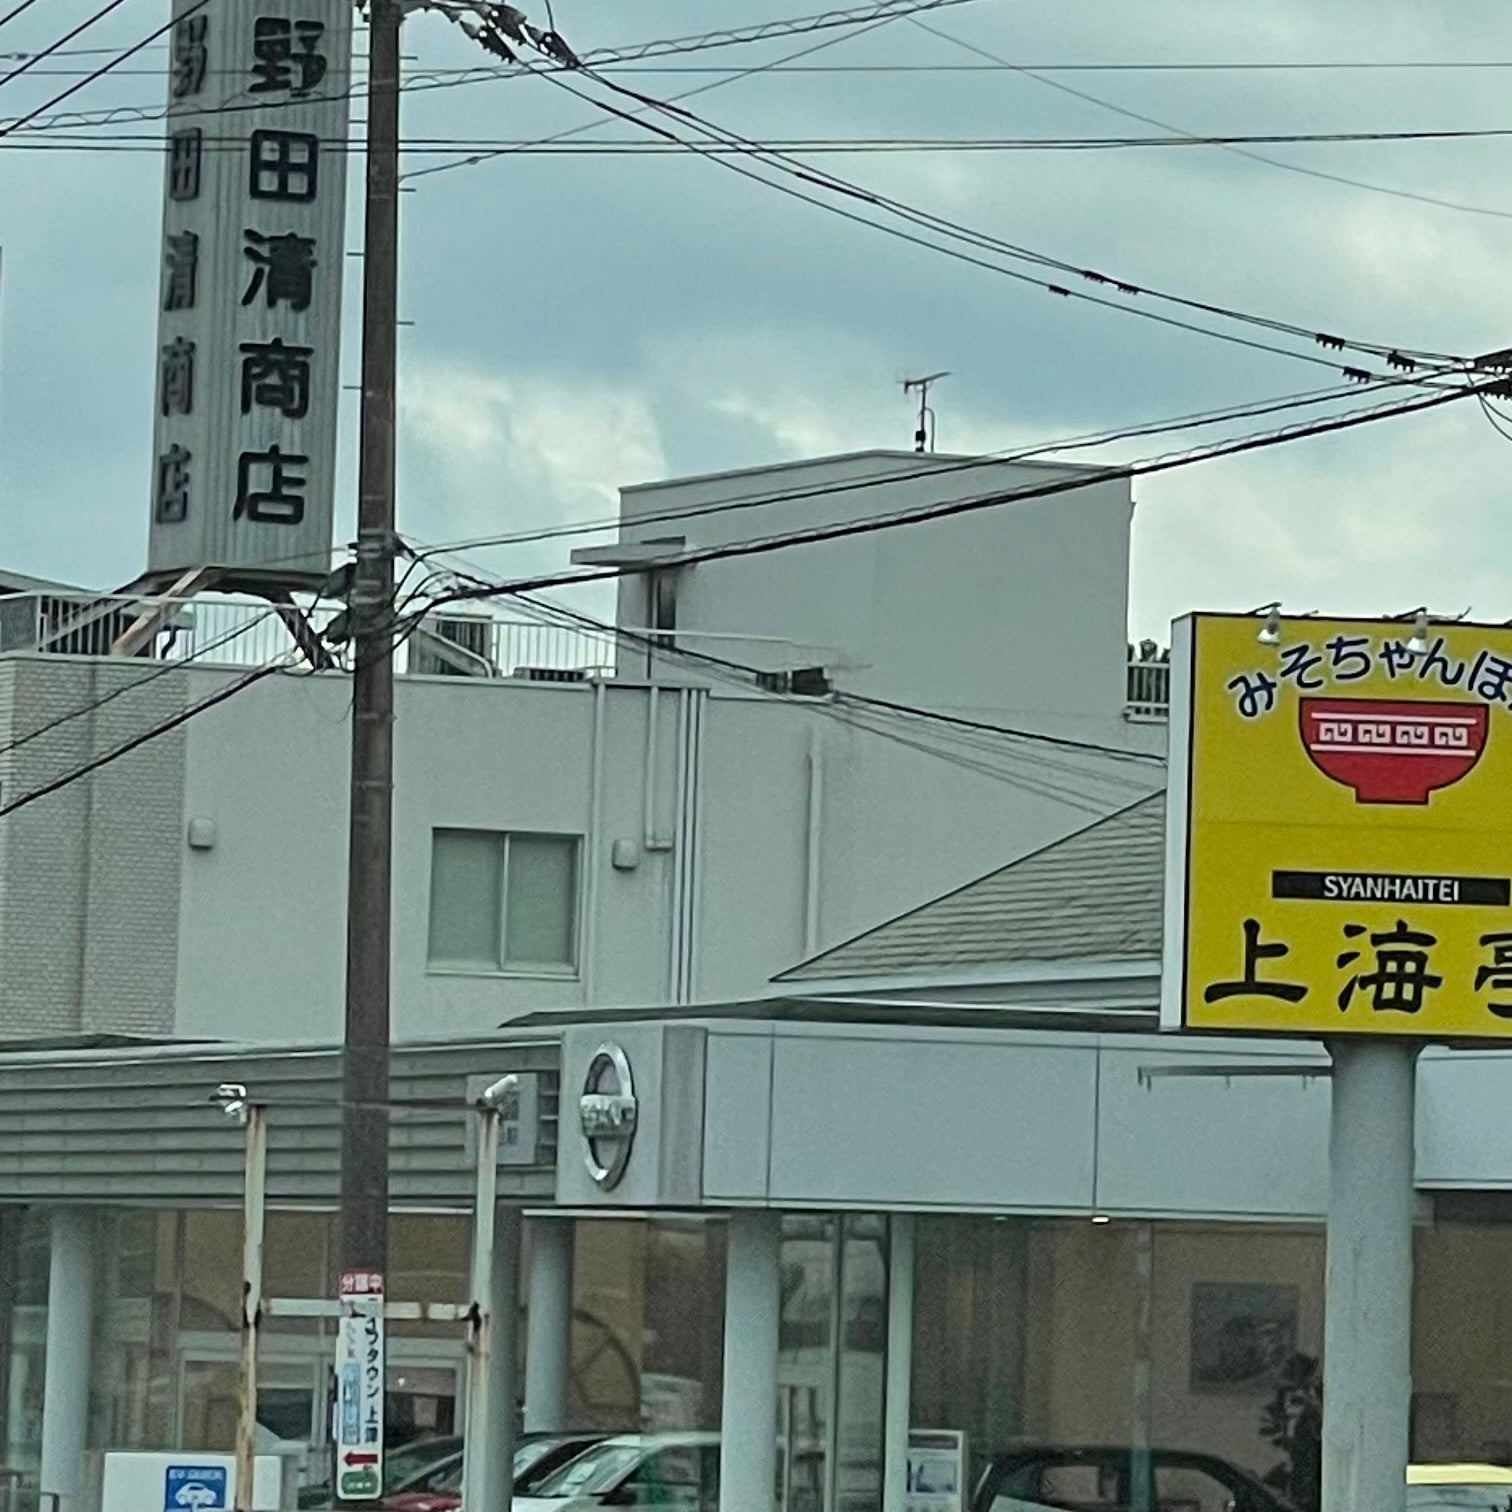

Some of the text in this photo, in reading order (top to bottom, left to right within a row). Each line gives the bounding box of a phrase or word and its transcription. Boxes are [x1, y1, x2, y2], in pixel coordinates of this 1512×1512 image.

[232, 16, 328, 525] 野田清商店
[1323, 875, 1460, 902] SYANHAITEI
